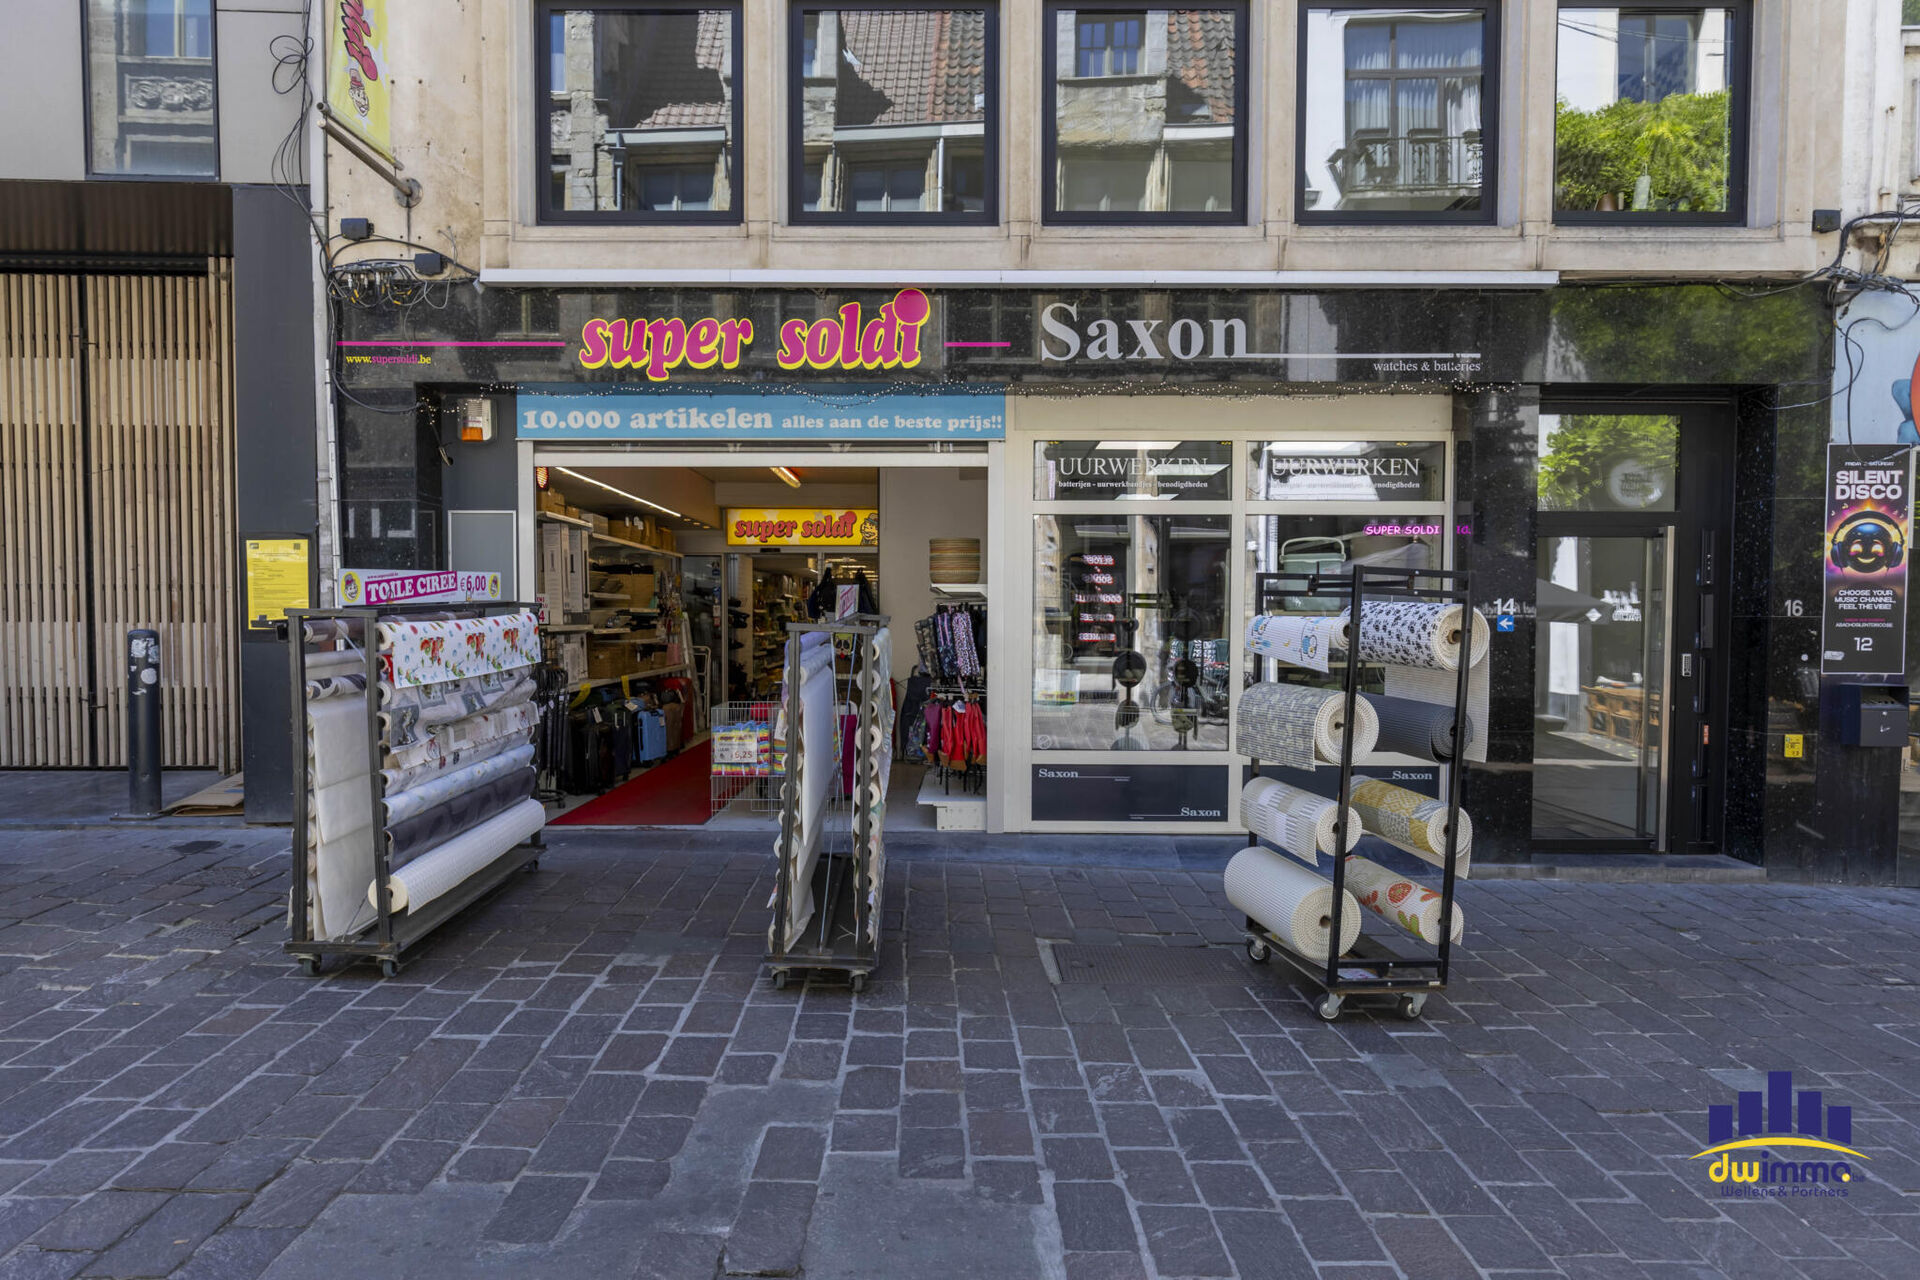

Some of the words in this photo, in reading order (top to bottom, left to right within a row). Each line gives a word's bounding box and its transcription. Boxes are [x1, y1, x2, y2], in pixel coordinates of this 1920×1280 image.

[579, 317, 753, 381] super
[777, 288, 930, 370] soldi
[1040, 302, 1248, 361] Saxon
[346, 354, 432, 365] www.supersoldi.be
[1373, 360, 1418, 371] watches
[1421, 362, 1430, 371] &
[1434, 360, 1481, 371] batteries
[523, 410, 620, 429] 10.000
[630, 408, 772, 429] artikelen
[782, 415, 824, 428] alles
[829, 417, 862, 428] aan
[867, 415, 889, 428] de
[894, 415, 942, 428] beste
[947, 415, 1003, 431] prijs!!
[1059, 457, 1208, 476] UURWERKEN
[1271, 458, 1420, 476] UURWERKEN
[1058, 480, 1091, 489] batterijen
[1836, 470, 1904, 485] SILENT
[1835, 484, 1902, 500] DISCO
[734, 520, 797, 543] super
[801, 511, 857, 538] soldi
[1364, 525, 1400, 535] SUPER
[1404, 525, 1440, 535] SOLDI
[367, 579, 415, 602] TOILE
[1493, 598, 1516, 615] 14
[1784, 599, 1803, 616] 16
[1854, 637, 1873, 651] 12
[1038, 768, 1079, 778] Saxon
[1392, 770, 1433, 780] Saxon
[1180, 807, 1221, 817] Saxon
